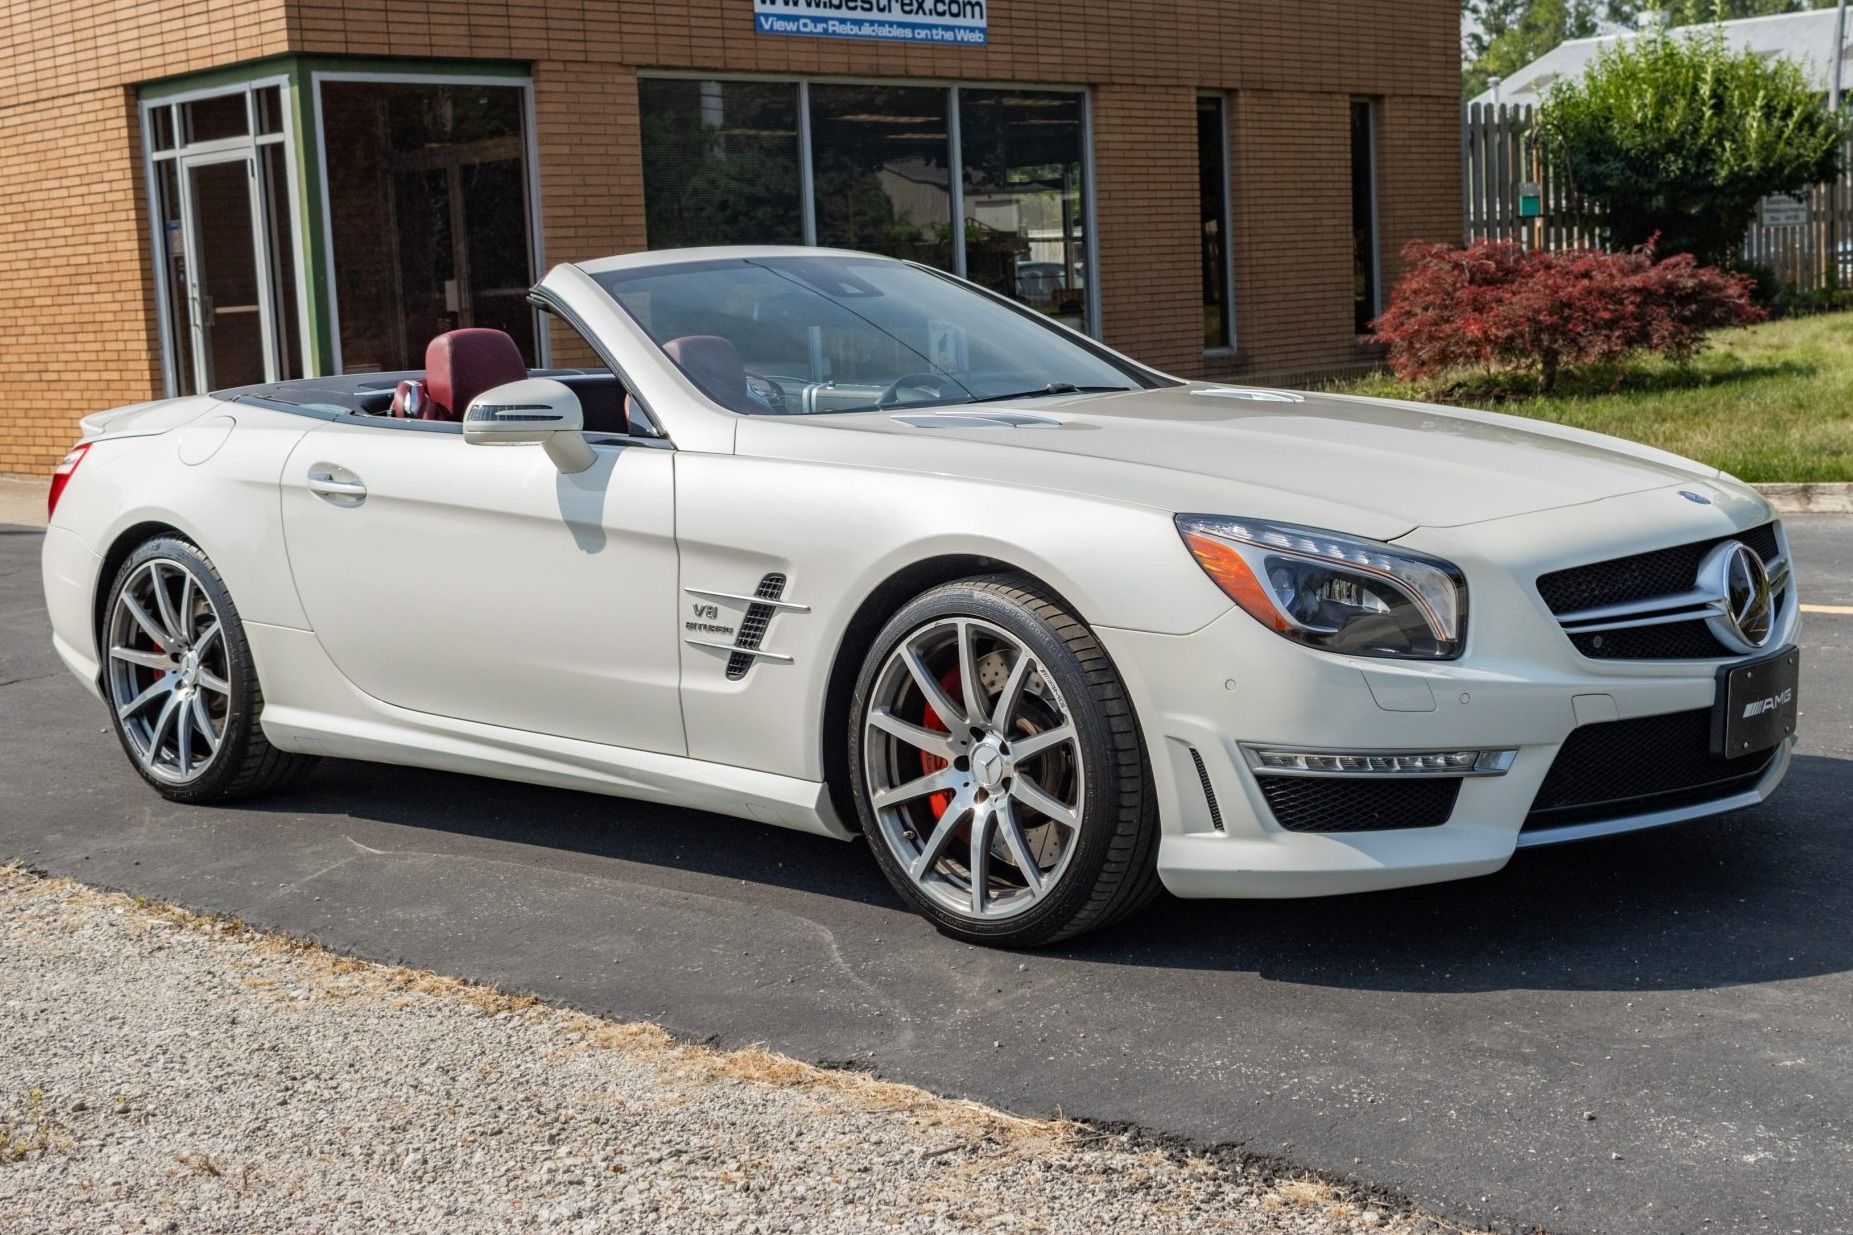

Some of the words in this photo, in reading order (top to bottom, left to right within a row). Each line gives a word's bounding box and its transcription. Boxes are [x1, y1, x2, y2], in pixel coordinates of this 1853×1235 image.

[760, 0, 984, 20] .estrex.com
[759, 15, 798, 32] View
[799, 18, 828, 33] Our
[828, 20, 913, 38] Rebuildables
[914, 29, 931, 40] on
[932, 27, 955, 41] the
[955, 28, 984, 42] Web
[692, 602, 718, 620] V8
